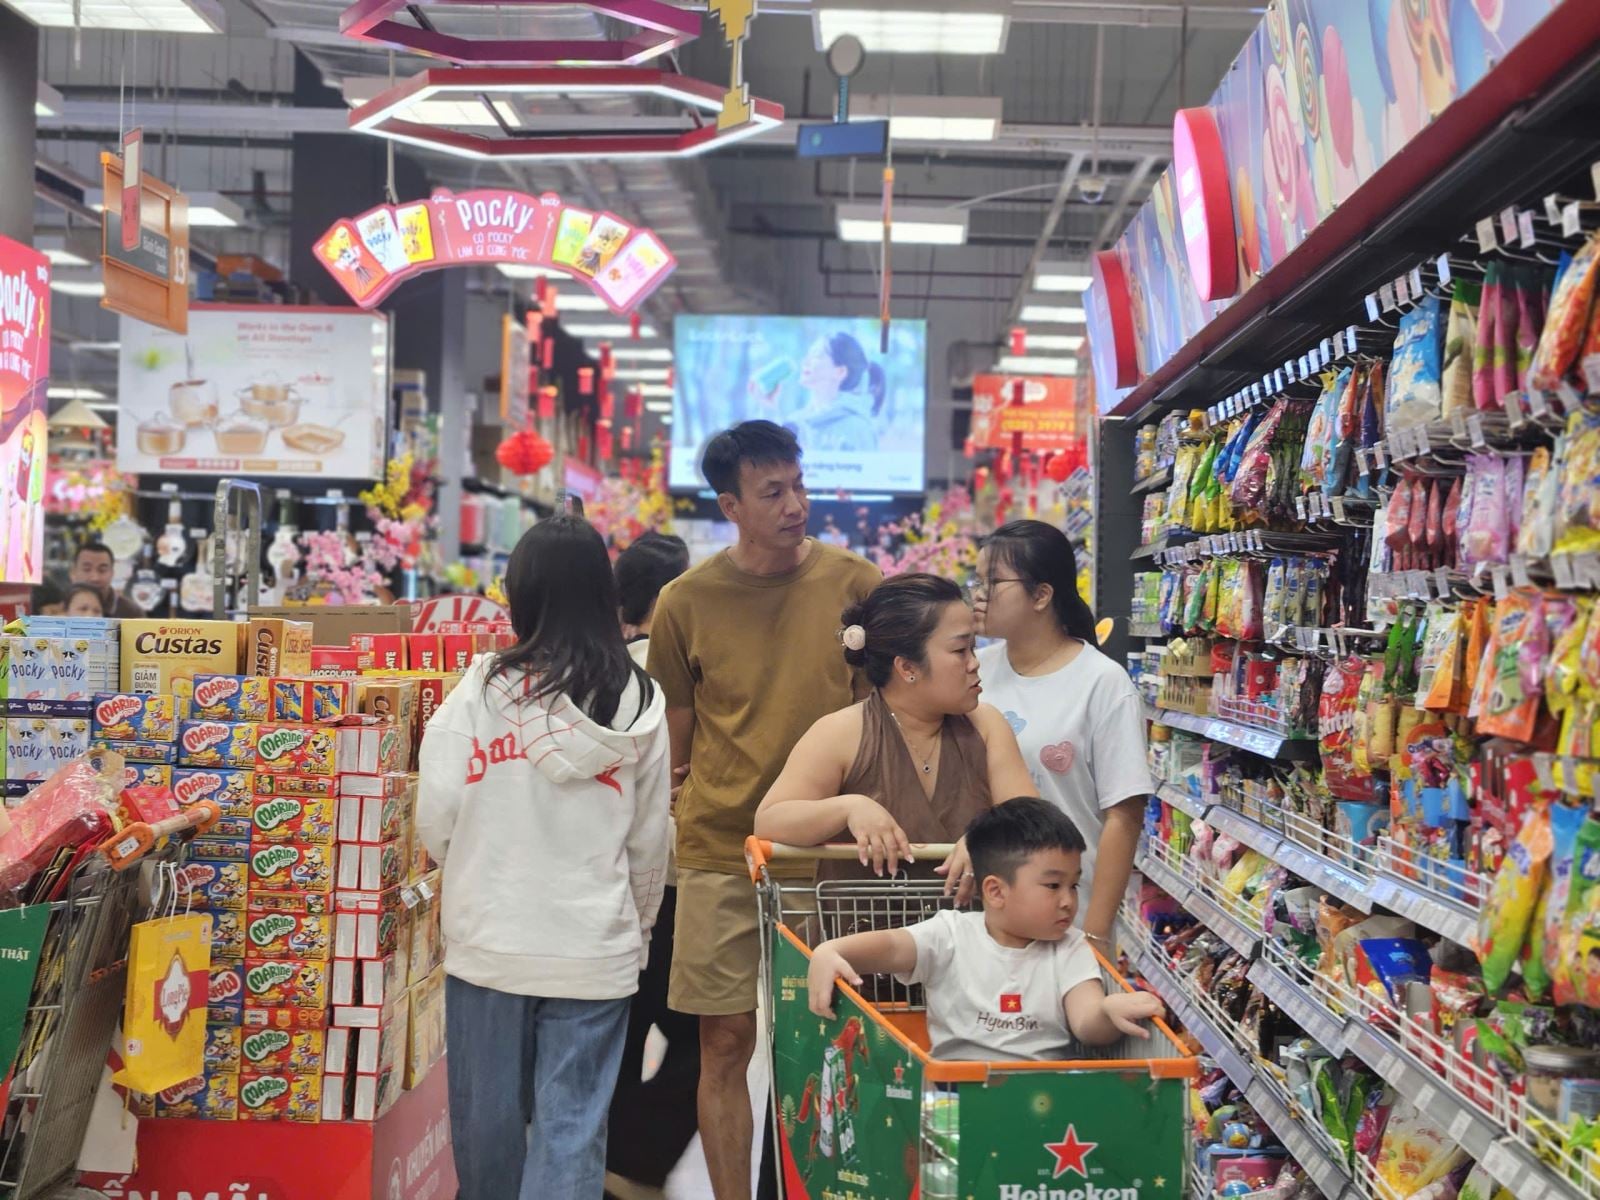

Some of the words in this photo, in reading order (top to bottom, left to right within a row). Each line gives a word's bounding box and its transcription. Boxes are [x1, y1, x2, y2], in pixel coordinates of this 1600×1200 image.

[173, 245, 187, 285] 13
[169, 627, 201, 635] ORION
[135, 632, 222, 655] Custas
[1, 947, 31, 962] THẬT
[998, 1182, 1139, 1200] Heineken
